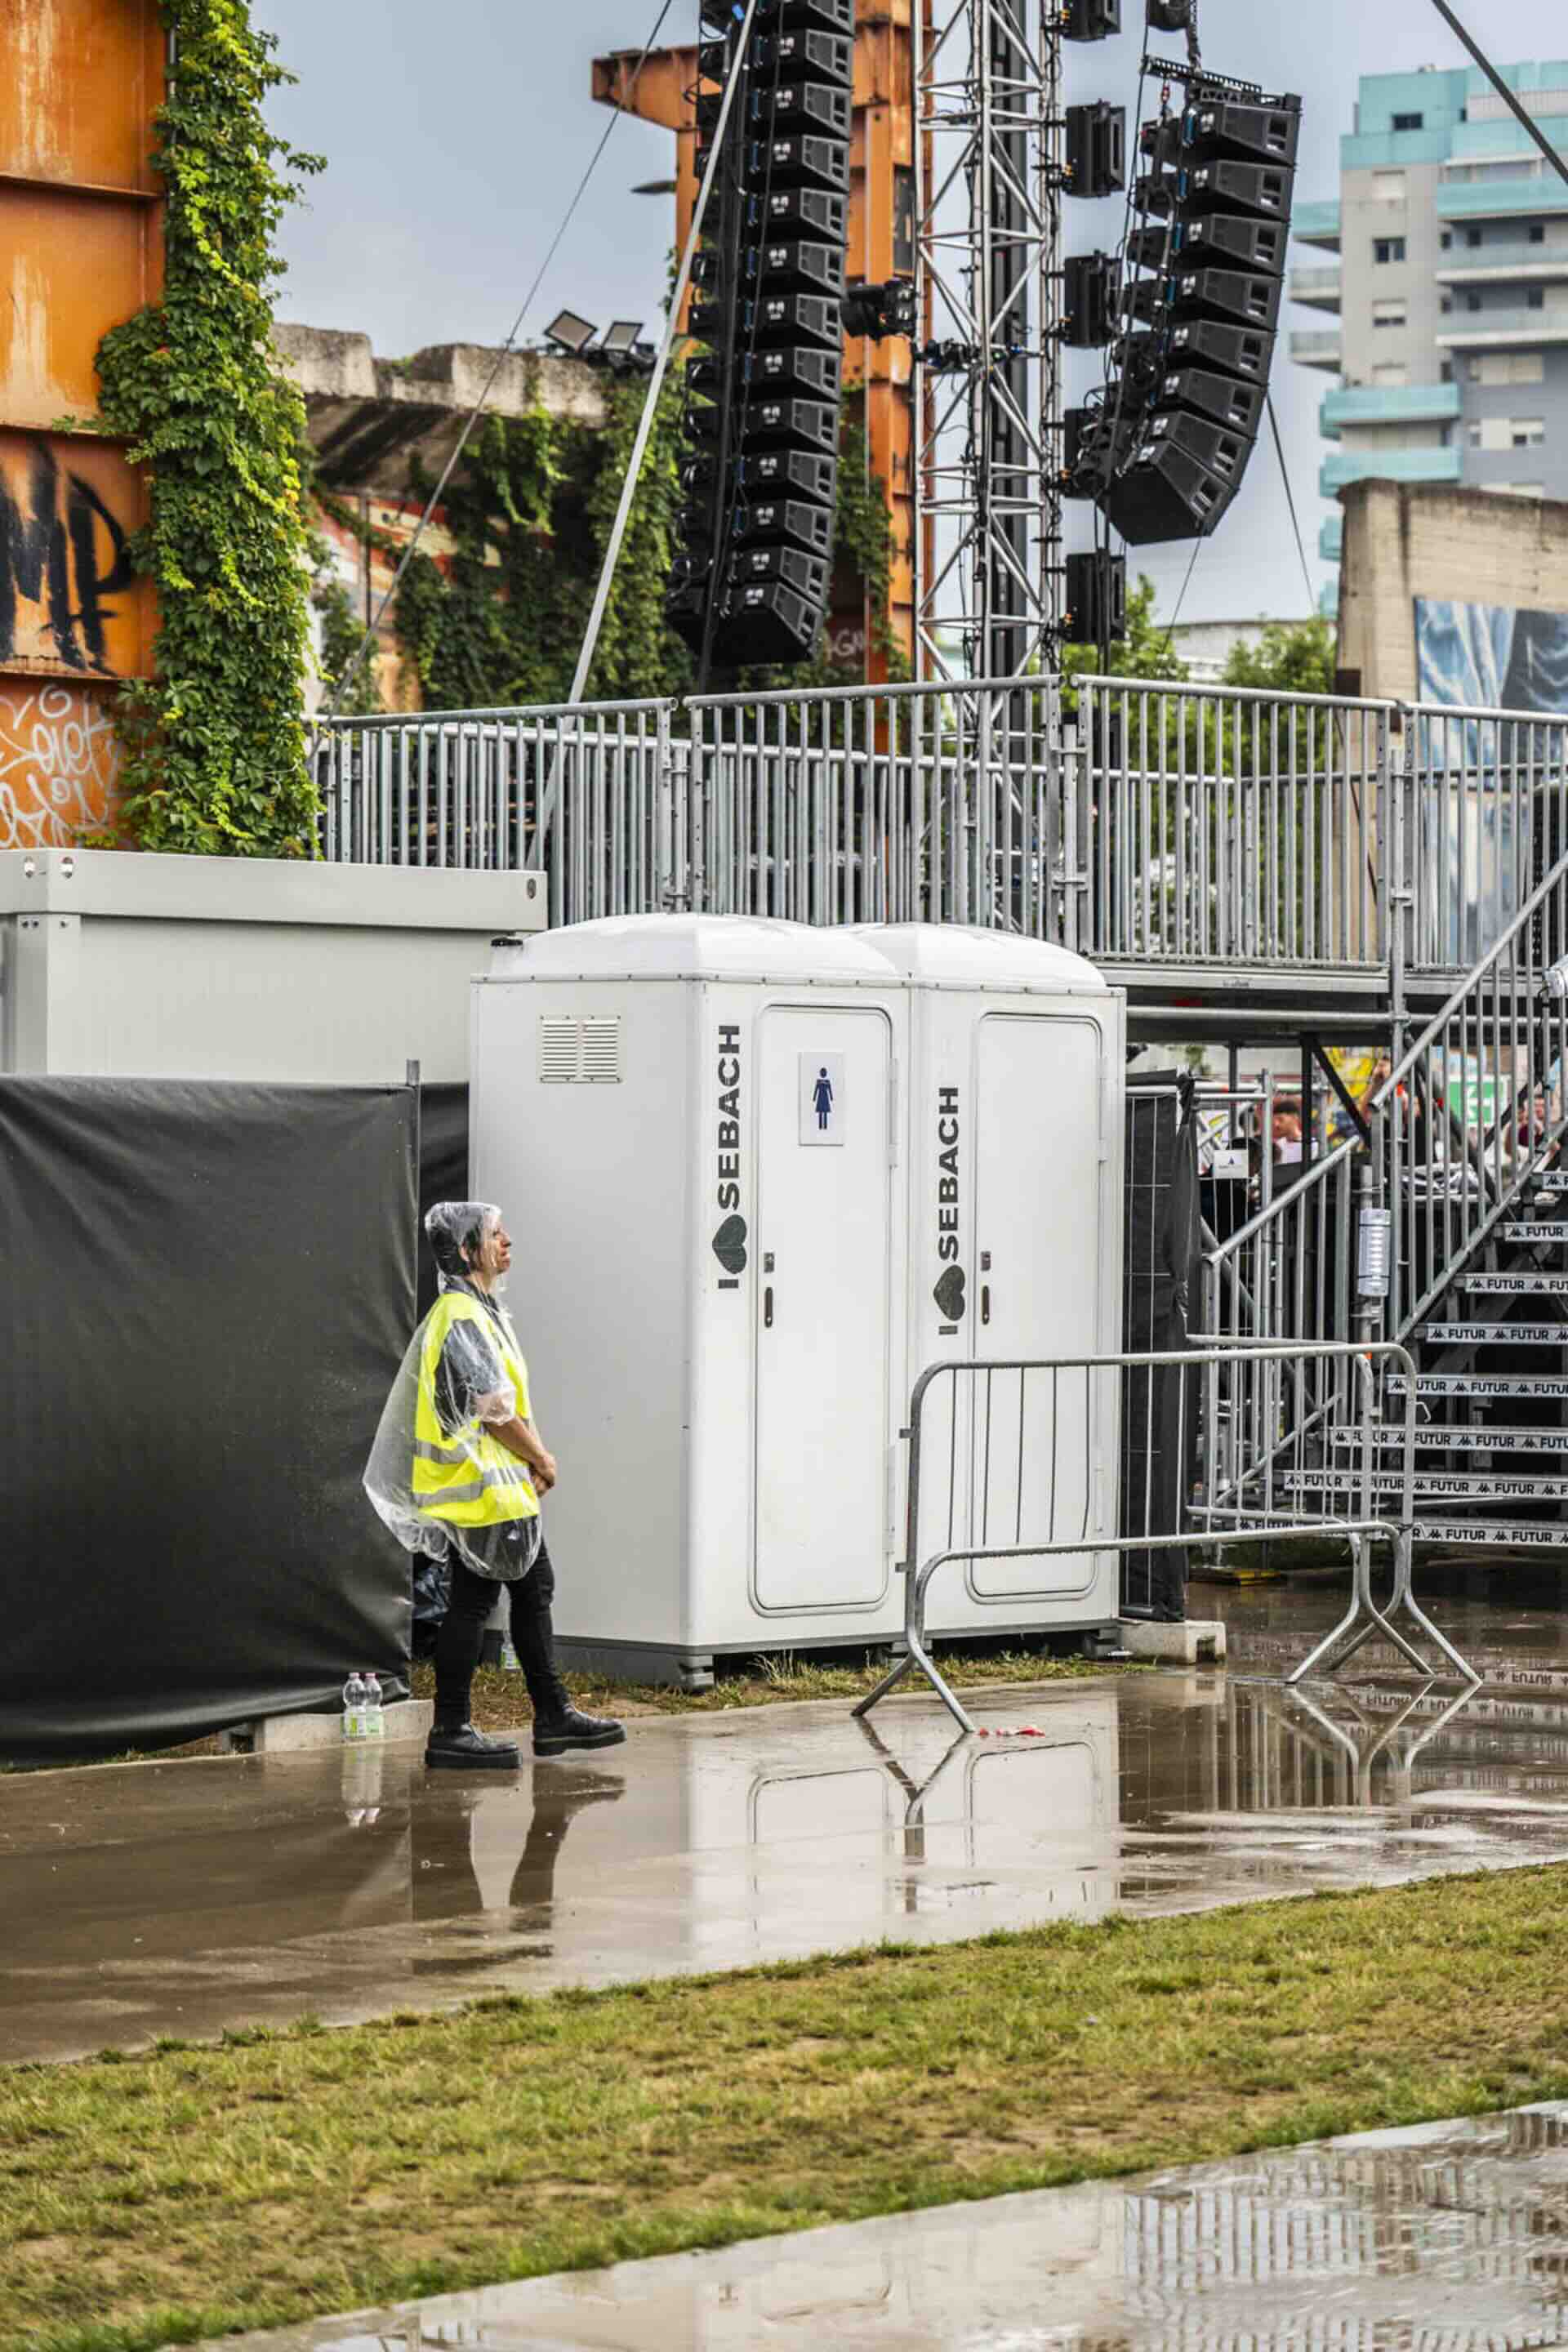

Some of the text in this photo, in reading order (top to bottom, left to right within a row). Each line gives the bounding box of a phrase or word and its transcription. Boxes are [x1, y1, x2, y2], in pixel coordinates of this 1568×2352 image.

[718, 1026, 740, 1210] SEBACH
[938, 1087, 959, 1262] SEBACH
[1526, 1227, 1563, 1237] FUTUR
[1487, 1279, 1525, 1290] FUTUR
[1448, 1329, 1549, 1340] FUTUR FUTUR
[1416, 1379, 1447, 1392] UTUR
[1471, 1382, 1509, 1393] FUTUR
[1476, 1435, 1515, 1447] FUTUR
[1373, 1477, 1404, 1489] UTUR
[1430, 1481, 1469, 1492] FUTUR
[1495, 1482, 1535, 1494] FUTUR
[1446, 1528, 1486, 1540] FUTUR
[1512, 1530, 1552, 1543] FUTUR
